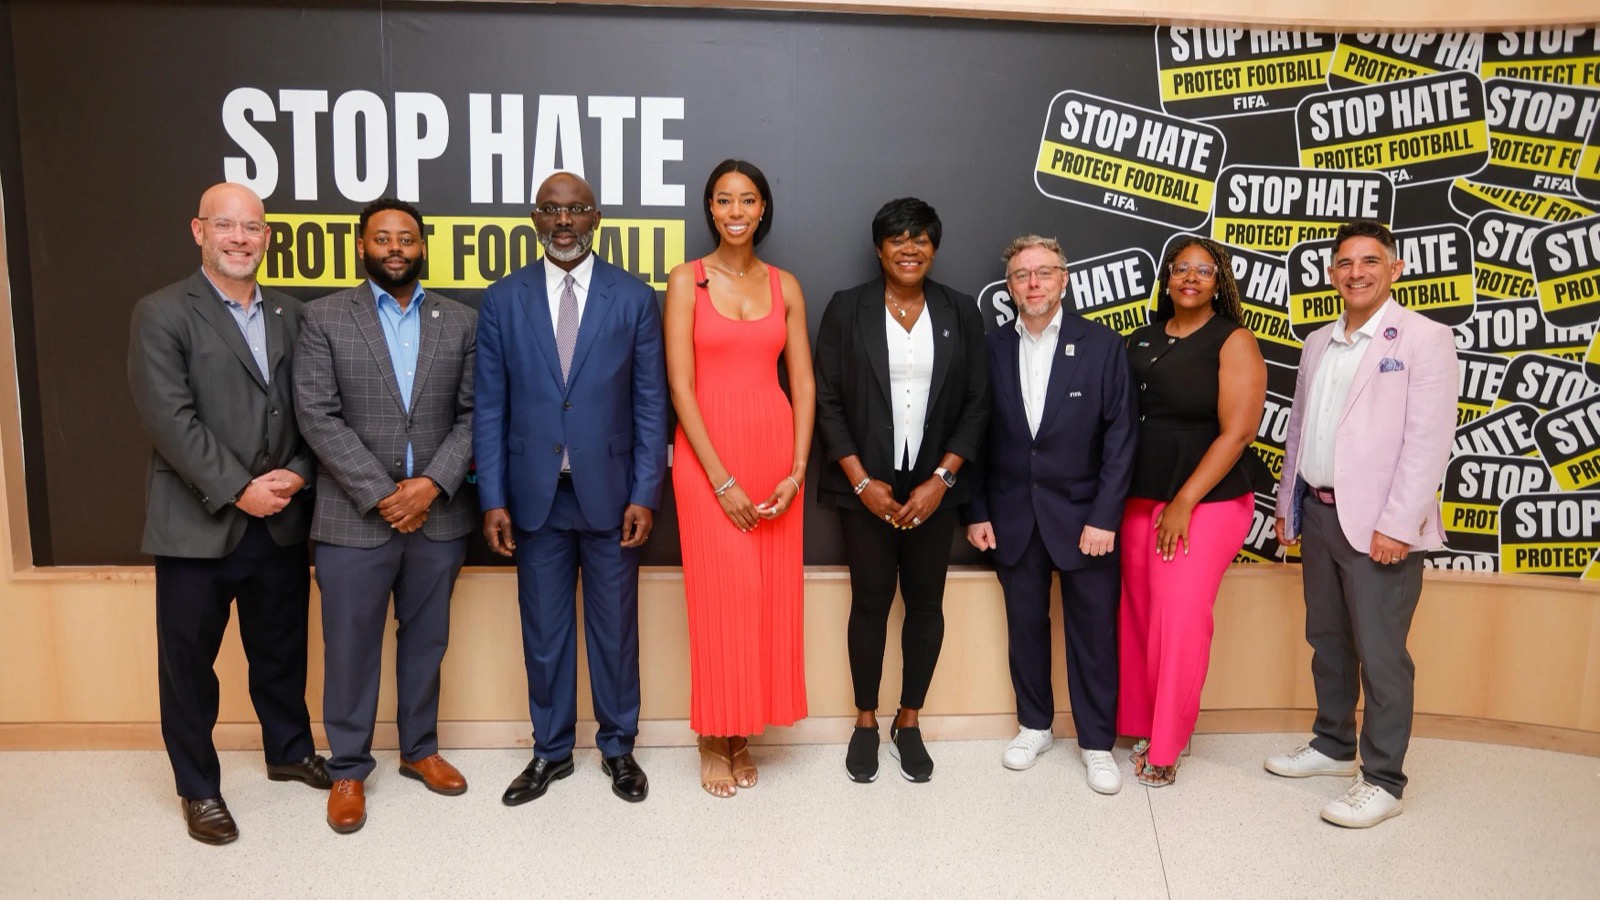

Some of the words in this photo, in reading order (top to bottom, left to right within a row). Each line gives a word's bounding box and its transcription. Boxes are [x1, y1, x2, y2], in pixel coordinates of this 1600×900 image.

[1173, 67, 1242, 95] PROTECT
[1247, 58, 1325, 87] FOOTBALL
[1233, 95, 1267, 110] FIFA
[1309, 93, 1385, 141] STOP
[1390, 78, 1471, 129] HATE
[1488, 86, 1575, 134] STOP
[222, 87, 449, 202] STOP
[469, 93, 686, 206] HATE
[1060, 100, 1138, 152] STOP
[1136, 119, 1213, 173] HATE
[1313, 143, 1383, 169] PROTECT
[1389, 128, 1473, 162] FOOTBALL
[1490, 138, 1556, 167] ROTECT
[1051, 148, 1122, 184] PROTECT
[1124, 166, 1199, 205] FOOTBALL
[1228, 174, 1302, 214] STOP
[1306, 178, 1380, 218] HATE
[1532, 174, 1572, 192] FIFA
[1103, 192, 1137, 212] FIFA
[453, 224, 670, 283] FOOALL
[1225, 223, 1293, 246] PROTECT
[1396, 232, 1458, 276] ATE
[1477, 219, 1541, 266] STO
[1070, 257, 1146, 310] HATE
[1245, 261, 1288, 307] HA
[1554, 275, 1600, 304] PROT
[1303, 295, 1344, 318] PROT
[1455, 307, 1538, 350] STOP
[1458, 461, 1544, 500] STOP
[1453, 507, 1499, 530] PROT
[1515, 499, 1600, 538] STOP
